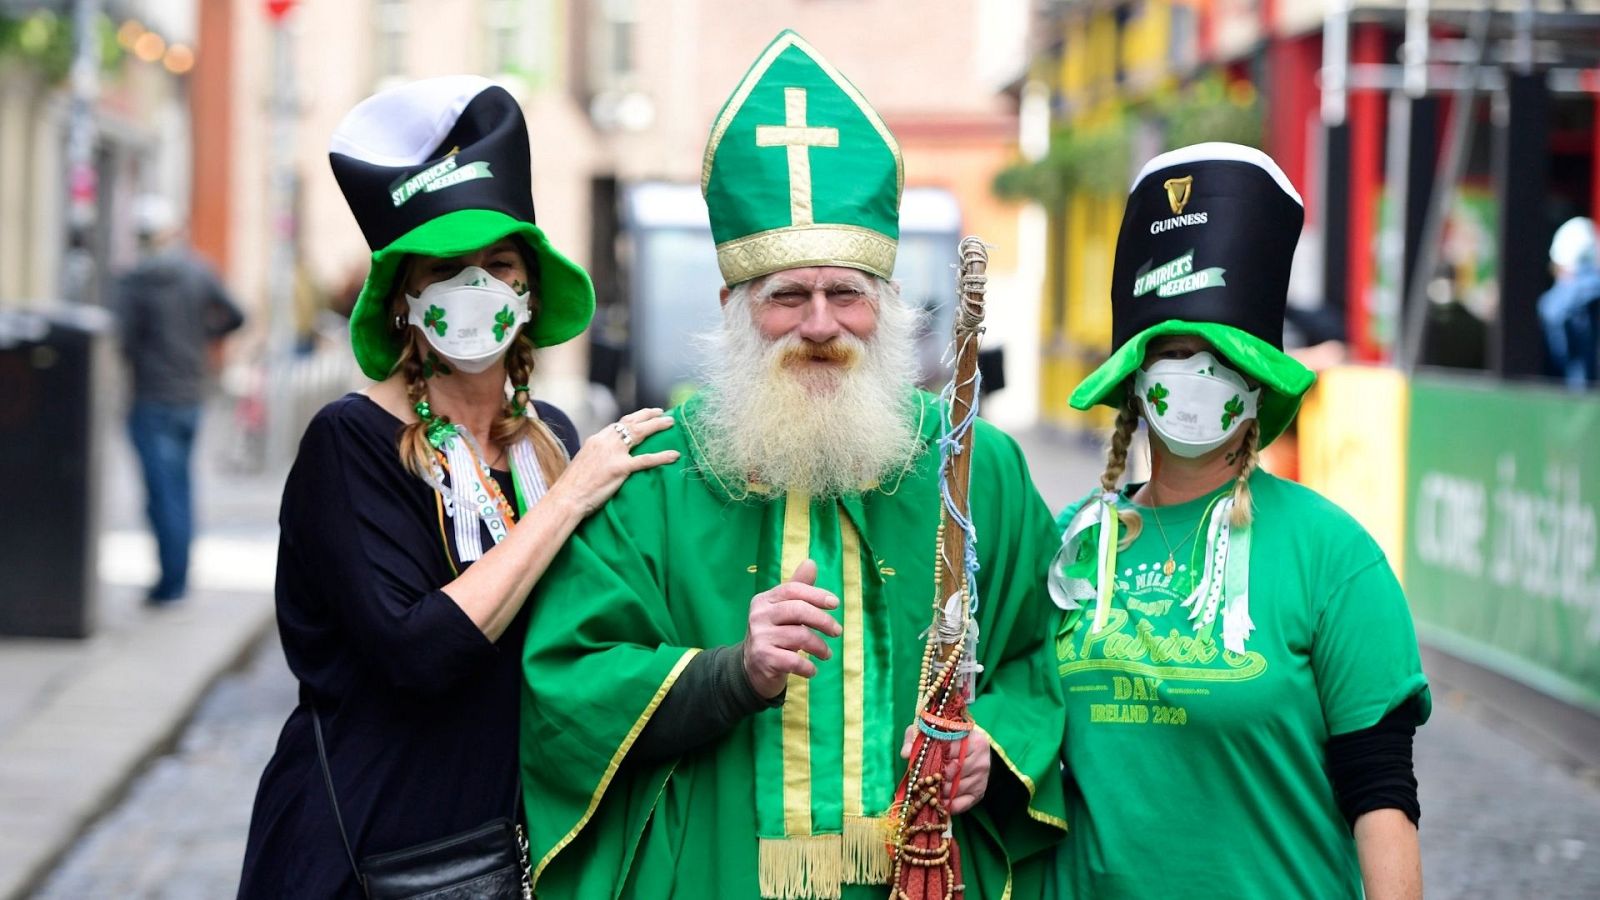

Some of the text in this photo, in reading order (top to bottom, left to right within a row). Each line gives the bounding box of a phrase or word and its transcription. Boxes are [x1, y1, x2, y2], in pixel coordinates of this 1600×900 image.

[426, 165, 477, 192] WEEKEND
[392, 186, 405, 207] ST
[1150, 212, 1208, 234] GUINNESS
[1133, 254, 1193, 297] ST PATRICK'S
[1158, 270, 1209, 297] WEEKEND
[457, 328, 478, 339] 3M
[1176, 411, 1199, 424] 3M
[1080, 607, 1263, 670] Patricks
[1113, 676, 1163, 701] DAY
[1090, 704, 1188, 726] IRELAND 2020
